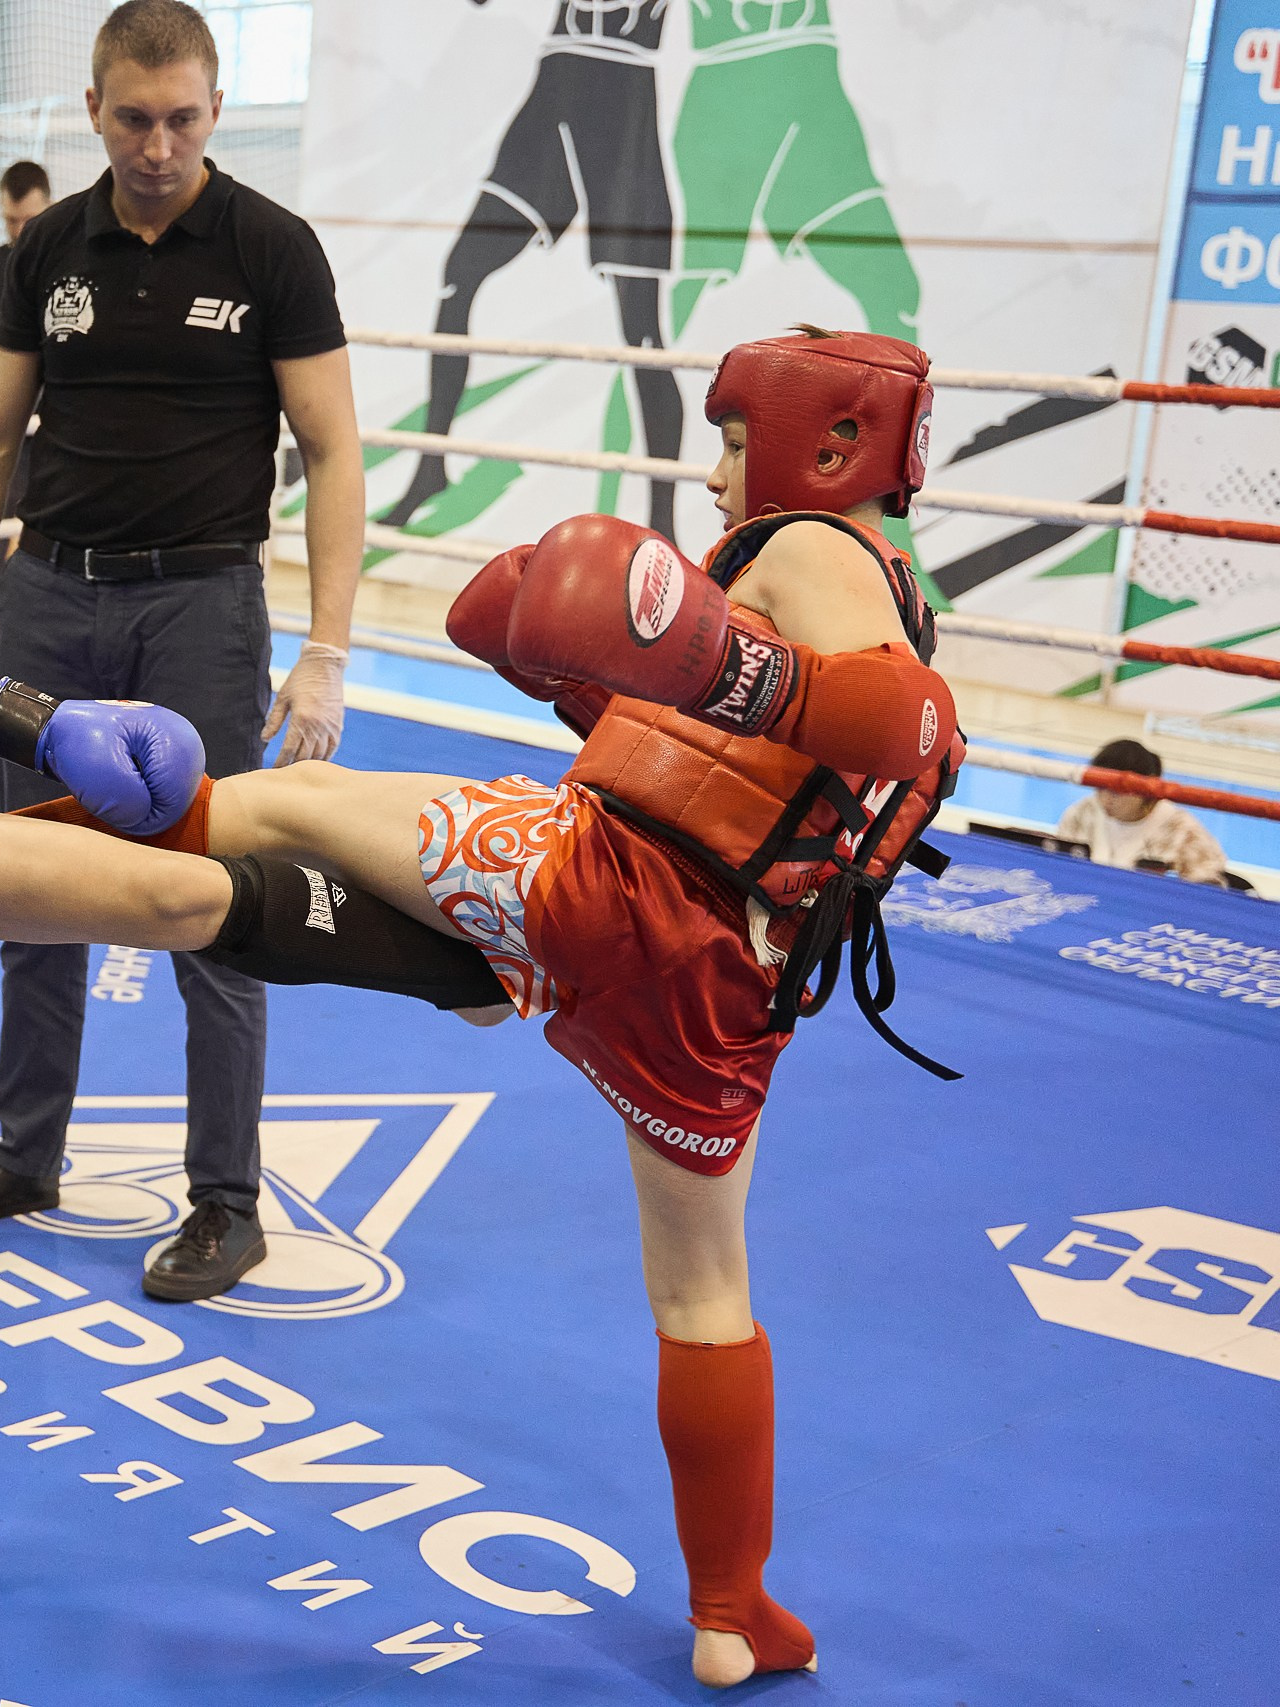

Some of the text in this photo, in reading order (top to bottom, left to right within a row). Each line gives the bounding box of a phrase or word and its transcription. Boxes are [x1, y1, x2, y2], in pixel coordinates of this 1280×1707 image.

[1217, 125, 1280, 186] Н
[1200, 227, 1280, 289] Ф
[706, 634, 773, 723] TWINS
[760, 675, 779, 709] SPECIAL
[293, 864, 336, 934] REYVE
[721, 1088, 748, 1098] STG
[1008, 1218, 1280, 1333] GS
